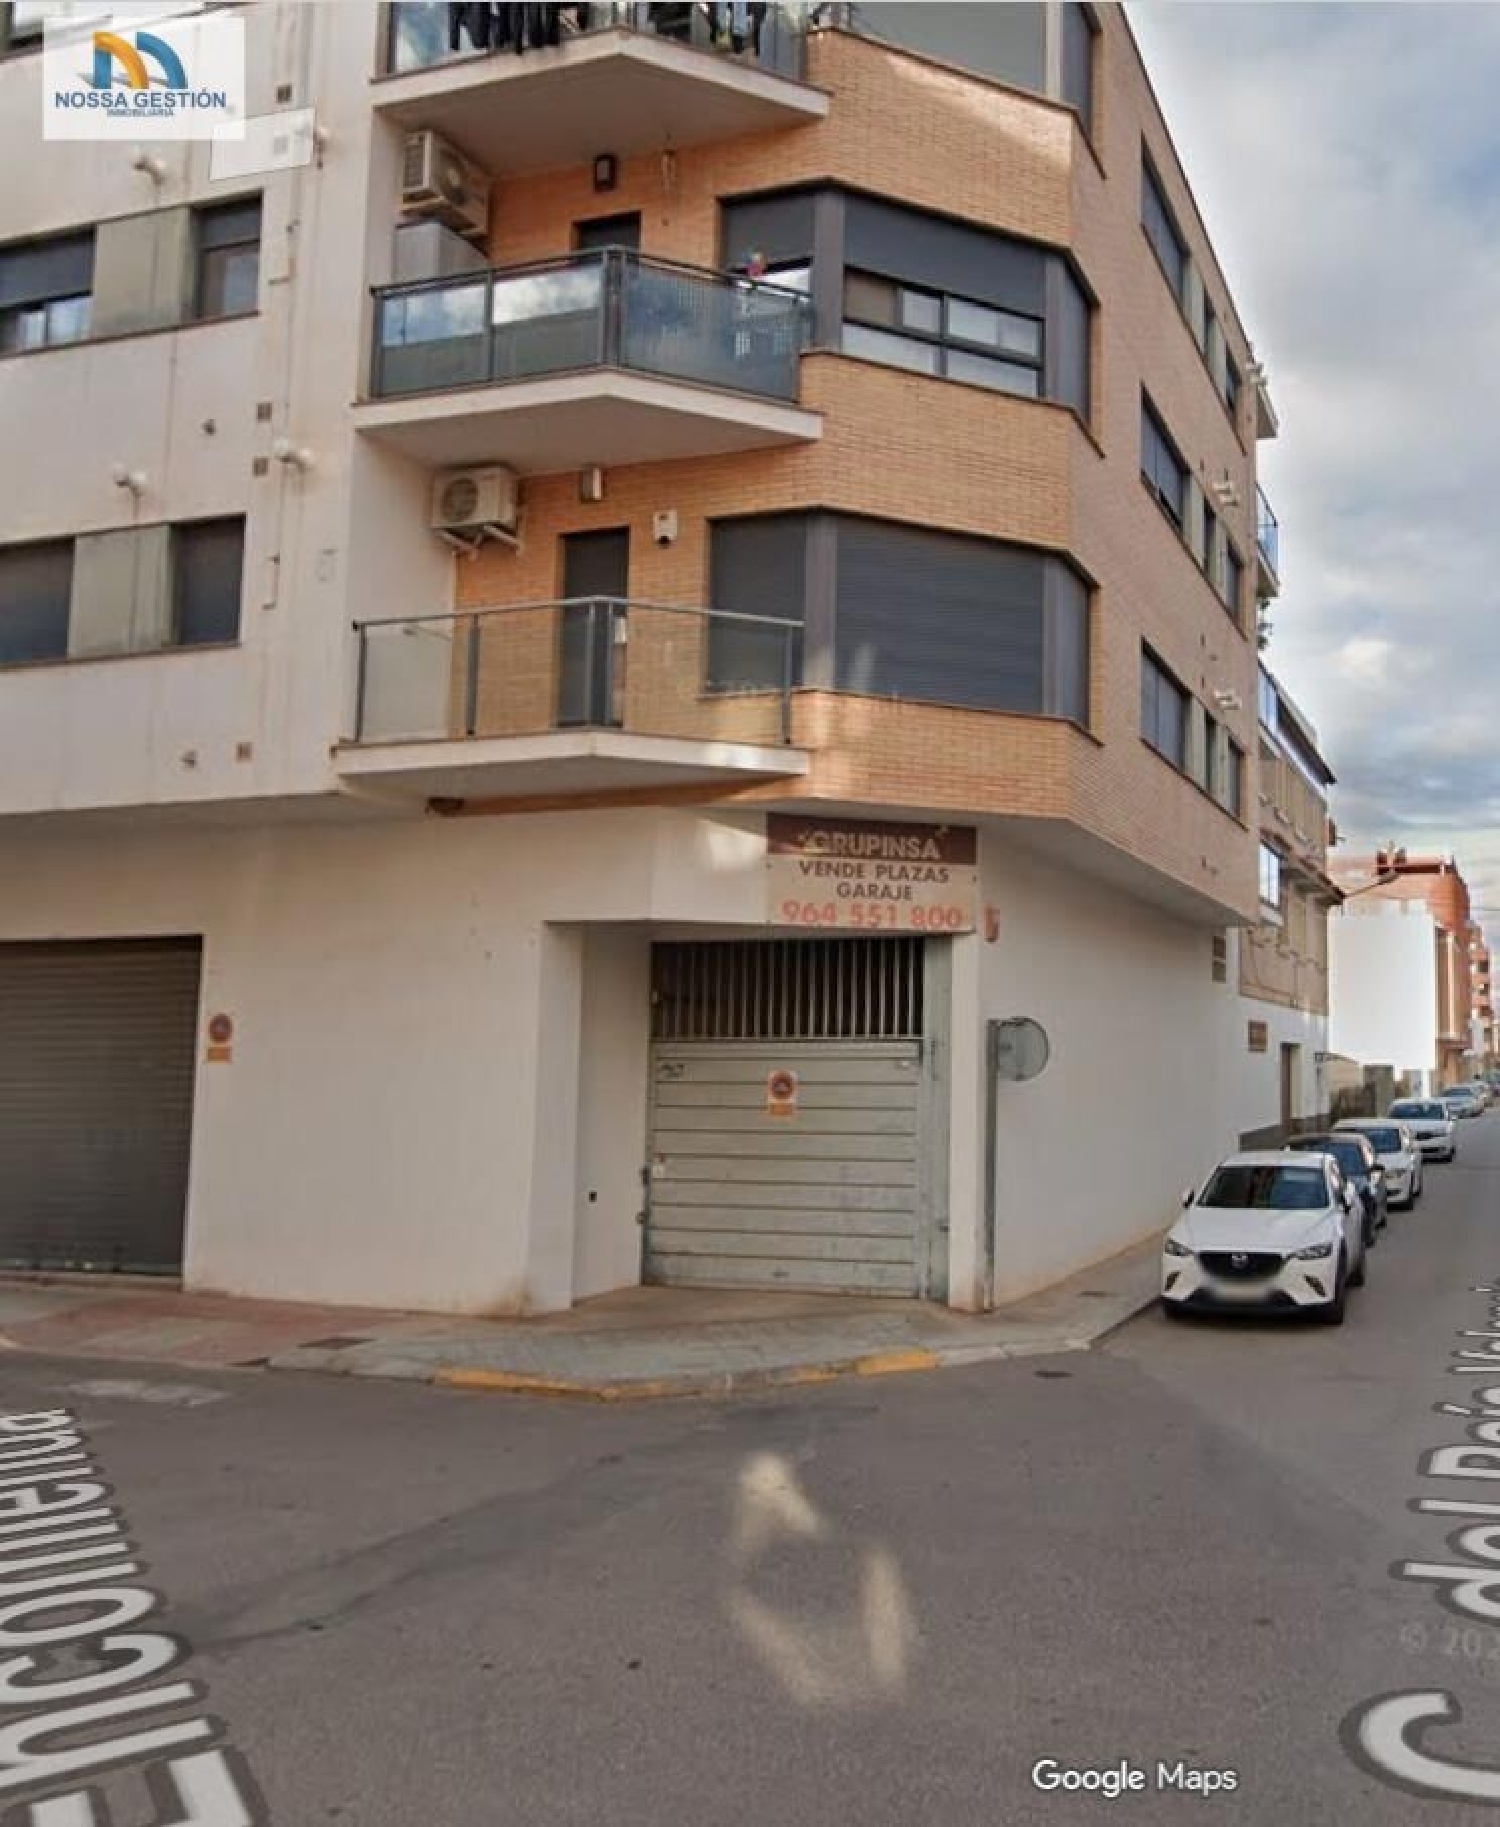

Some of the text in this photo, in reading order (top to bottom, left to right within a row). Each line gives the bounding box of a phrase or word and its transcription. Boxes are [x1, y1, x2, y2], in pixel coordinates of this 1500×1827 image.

[812, 831, 941, 860] GRUPINSA
[800, 861, 949, 884] VENDE PLAZAS
[836, 882, 913, 901] GARAJE
[781, 900, 963, 928] 964 551 800
